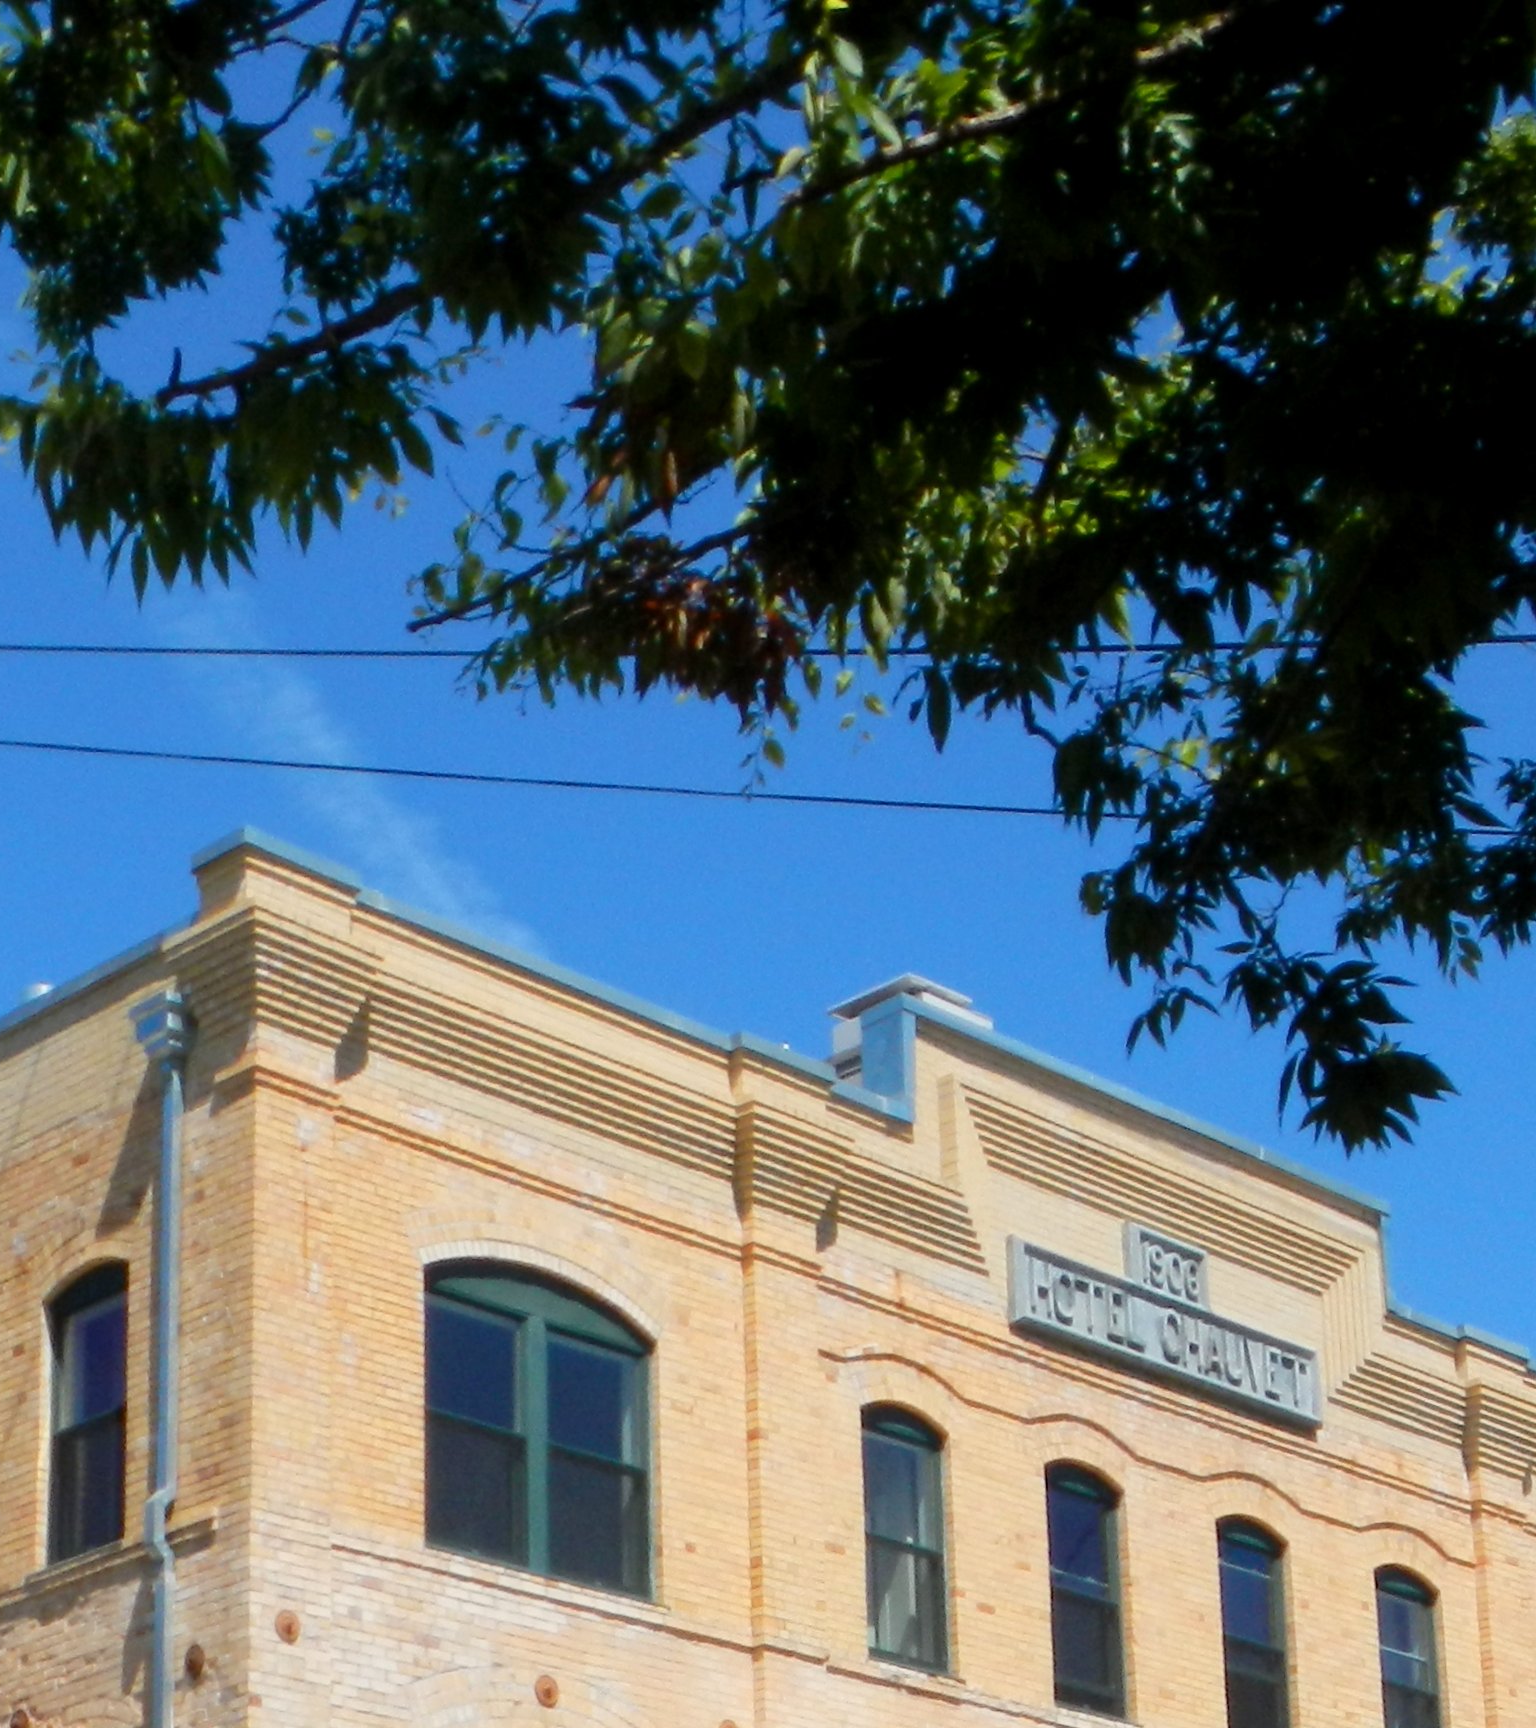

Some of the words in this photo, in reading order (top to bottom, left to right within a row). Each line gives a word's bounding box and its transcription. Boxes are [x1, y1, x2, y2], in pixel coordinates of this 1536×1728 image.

[1142, 1240, 1201, 1302] 1906
[1026, 1254, 1145, 1353] HOTEL
[1158, 1305, 1308, 1409] CHAUVET
